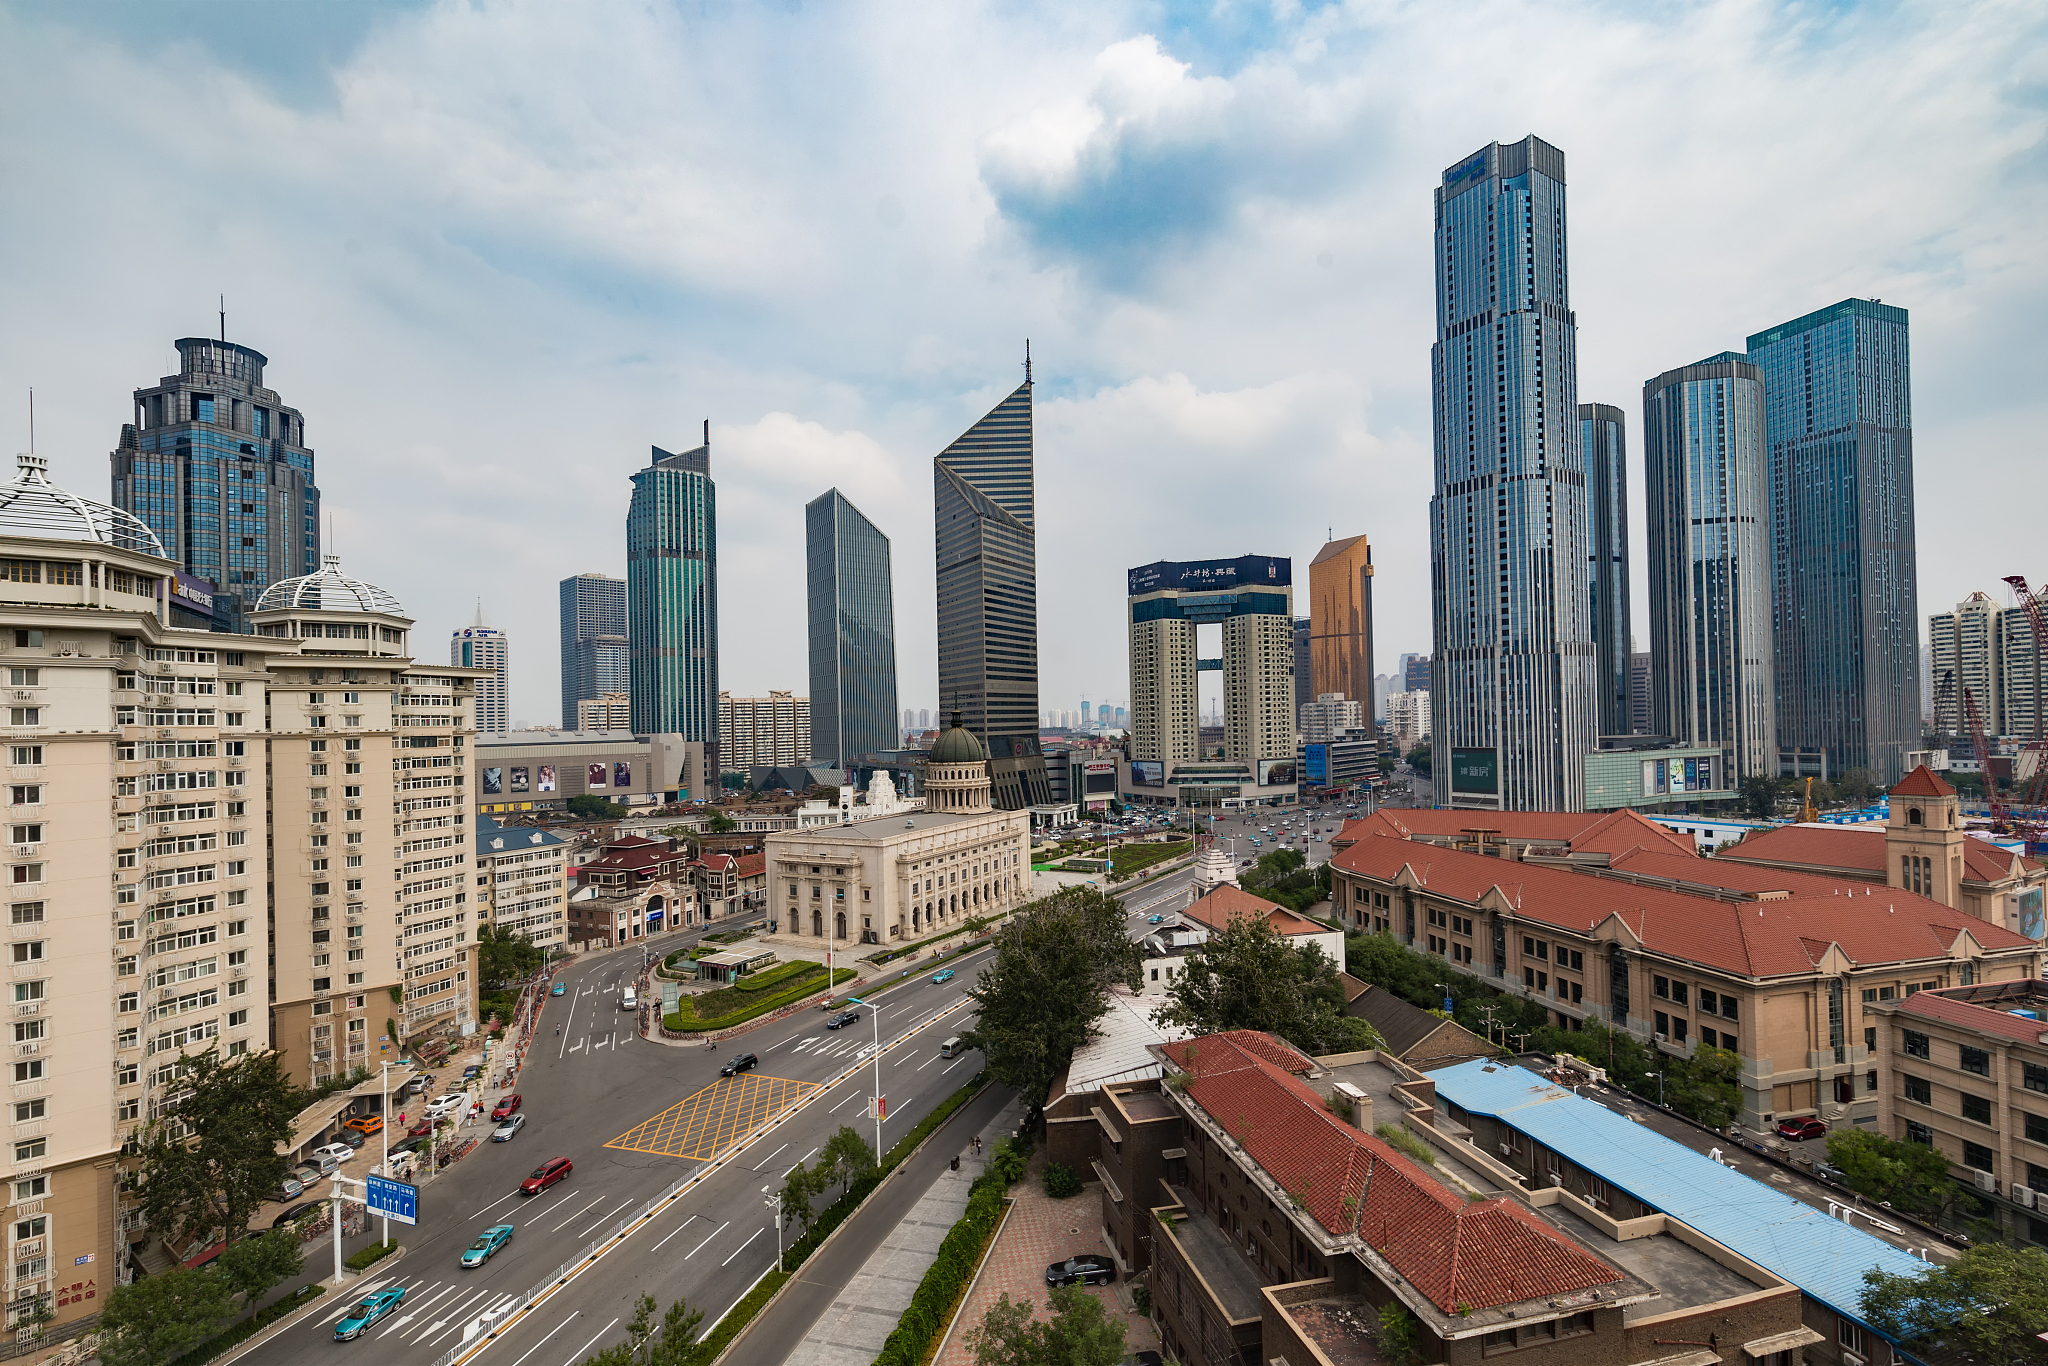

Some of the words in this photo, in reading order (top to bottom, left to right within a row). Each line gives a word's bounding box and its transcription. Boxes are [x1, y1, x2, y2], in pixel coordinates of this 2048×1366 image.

[57, 1278, 96, 1297] 大明人
[57, 1289, 96, 1308] 眼镜店
